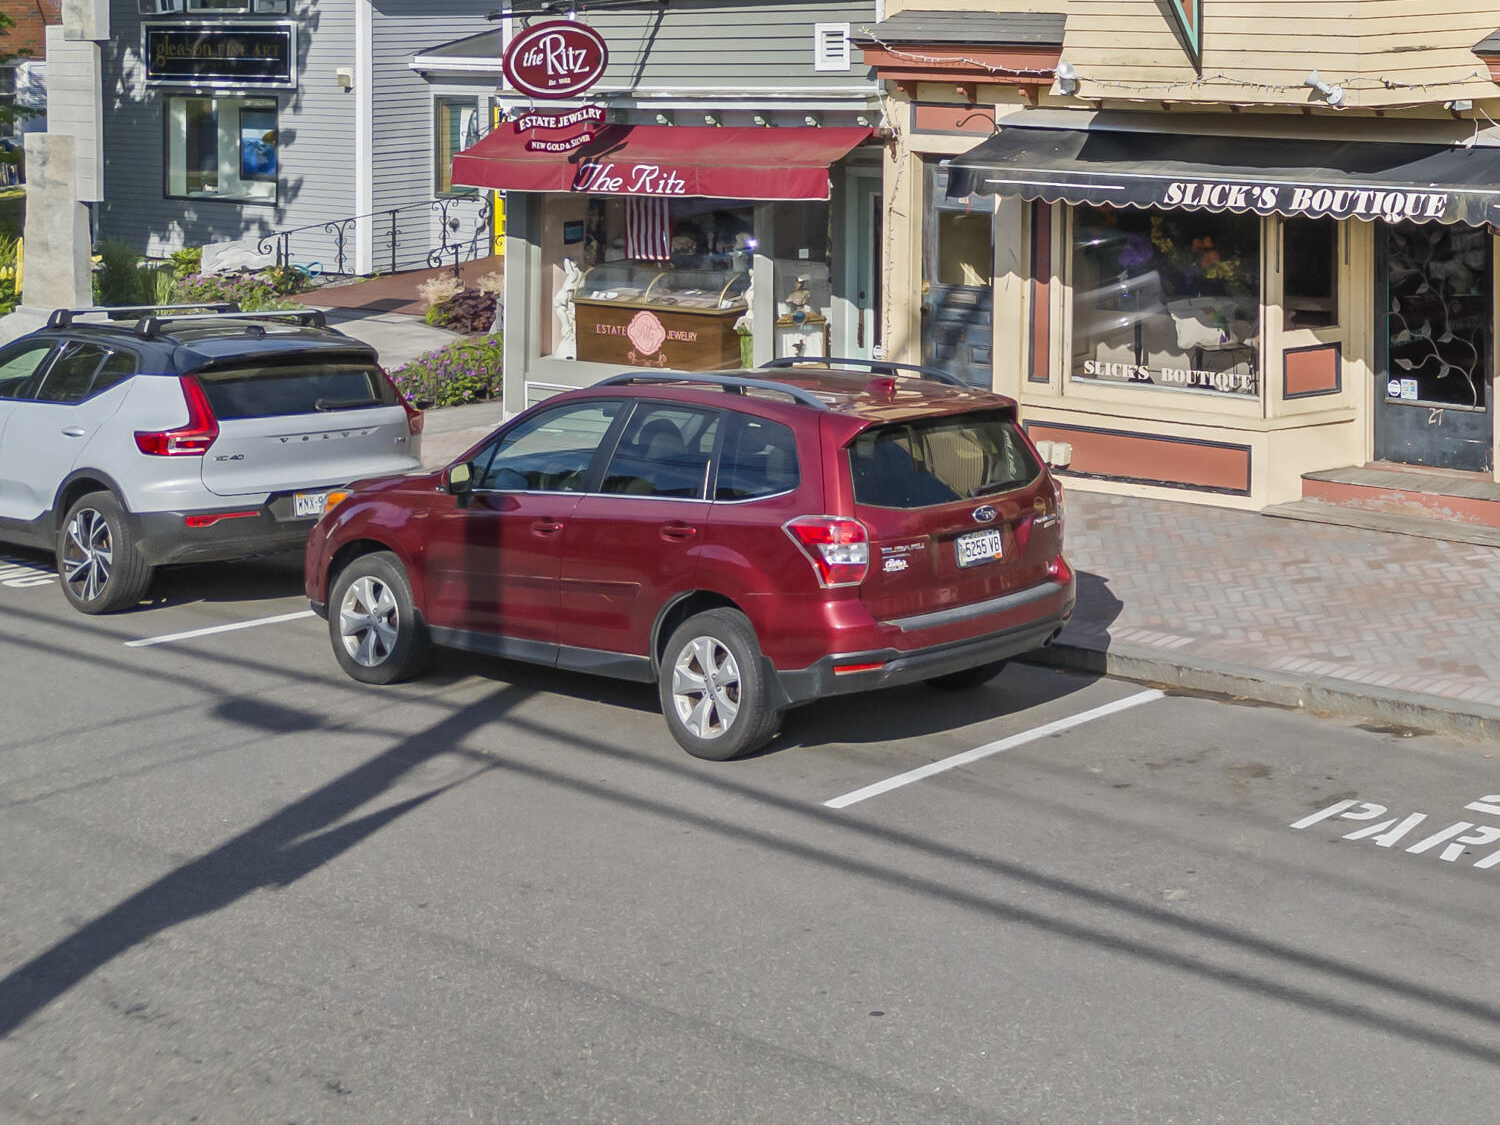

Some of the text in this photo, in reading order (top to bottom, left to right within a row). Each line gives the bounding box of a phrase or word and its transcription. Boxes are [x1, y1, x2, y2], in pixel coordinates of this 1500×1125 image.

[155, 34, 212, 67] gleason
[216, 43, 248, 57] FINE
[253, 42, 281, 57] ART
[522, 33, 590, 76] the Ritz
[519, 107, 602, 131] ESTATE JEWELRY
[531, 141, 546, 150] NEW
[546, 142, 566, 151] GOLD
[573, 162, 686, 194] The Ritz
[1163, 180, 1449, 223] SLICK'S BOUTIQUE
[596, 323, 699, 342] ESTATE JEWELRY
[1083, 360, 1253, 393] SLICK'S BOUTIQUE
[1428, 407, 1445, 426] 27
[279, 429, 370, 444] VOLVO
[965, 538, 988, 558] 5255
